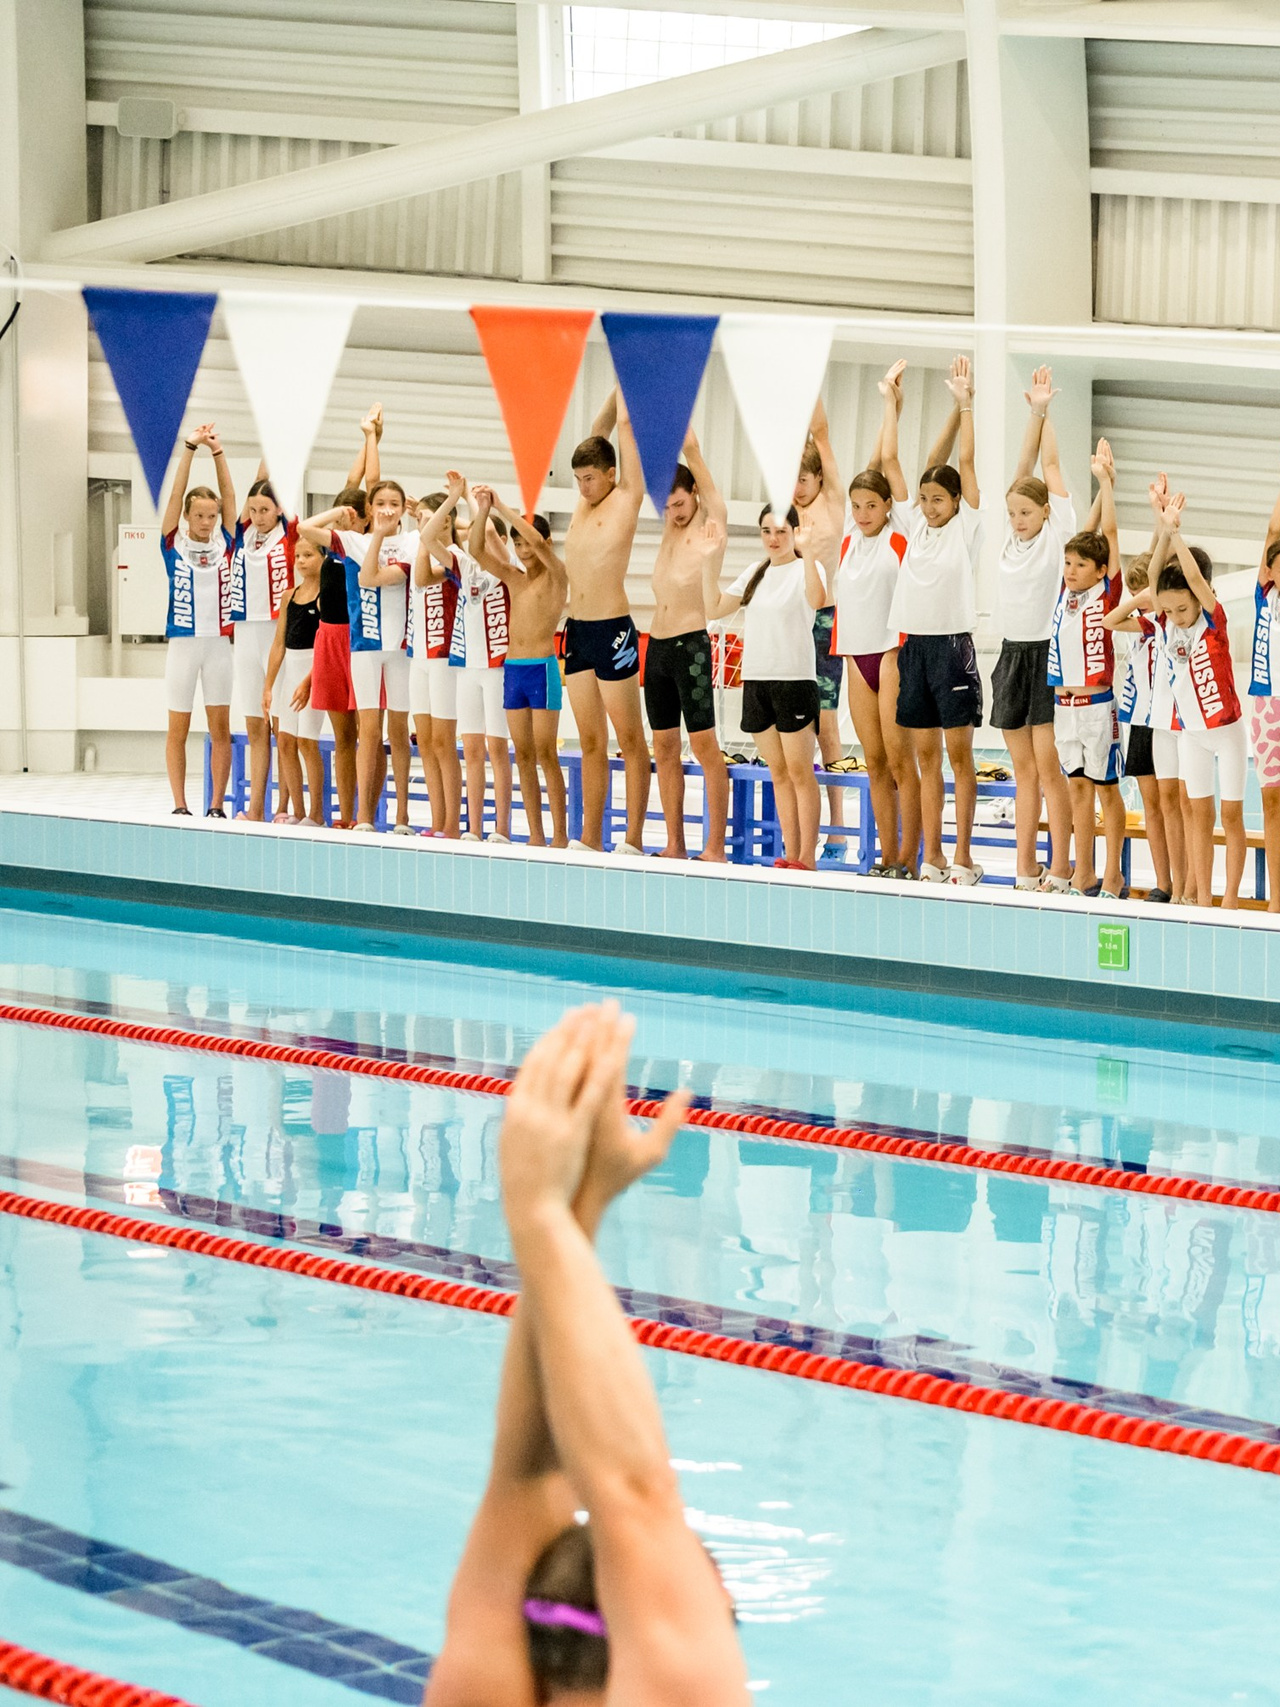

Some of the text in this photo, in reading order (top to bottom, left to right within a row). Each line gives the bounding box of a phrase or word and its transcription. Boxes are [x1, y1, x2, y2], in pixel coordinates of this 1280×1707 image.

[174, 559, 193, 628] RUSSIA
[427, 583, 446, 649] RUSSIA
[486, 585, 509, 658] RUSSIA
[612, 631, 626, 649] FILA
[1085, 600, 1106, 676] RUSSIA
[1254, 606, 1272, 685] RUSSIA
[1191, 639, 1224, 718] RUSSIA
